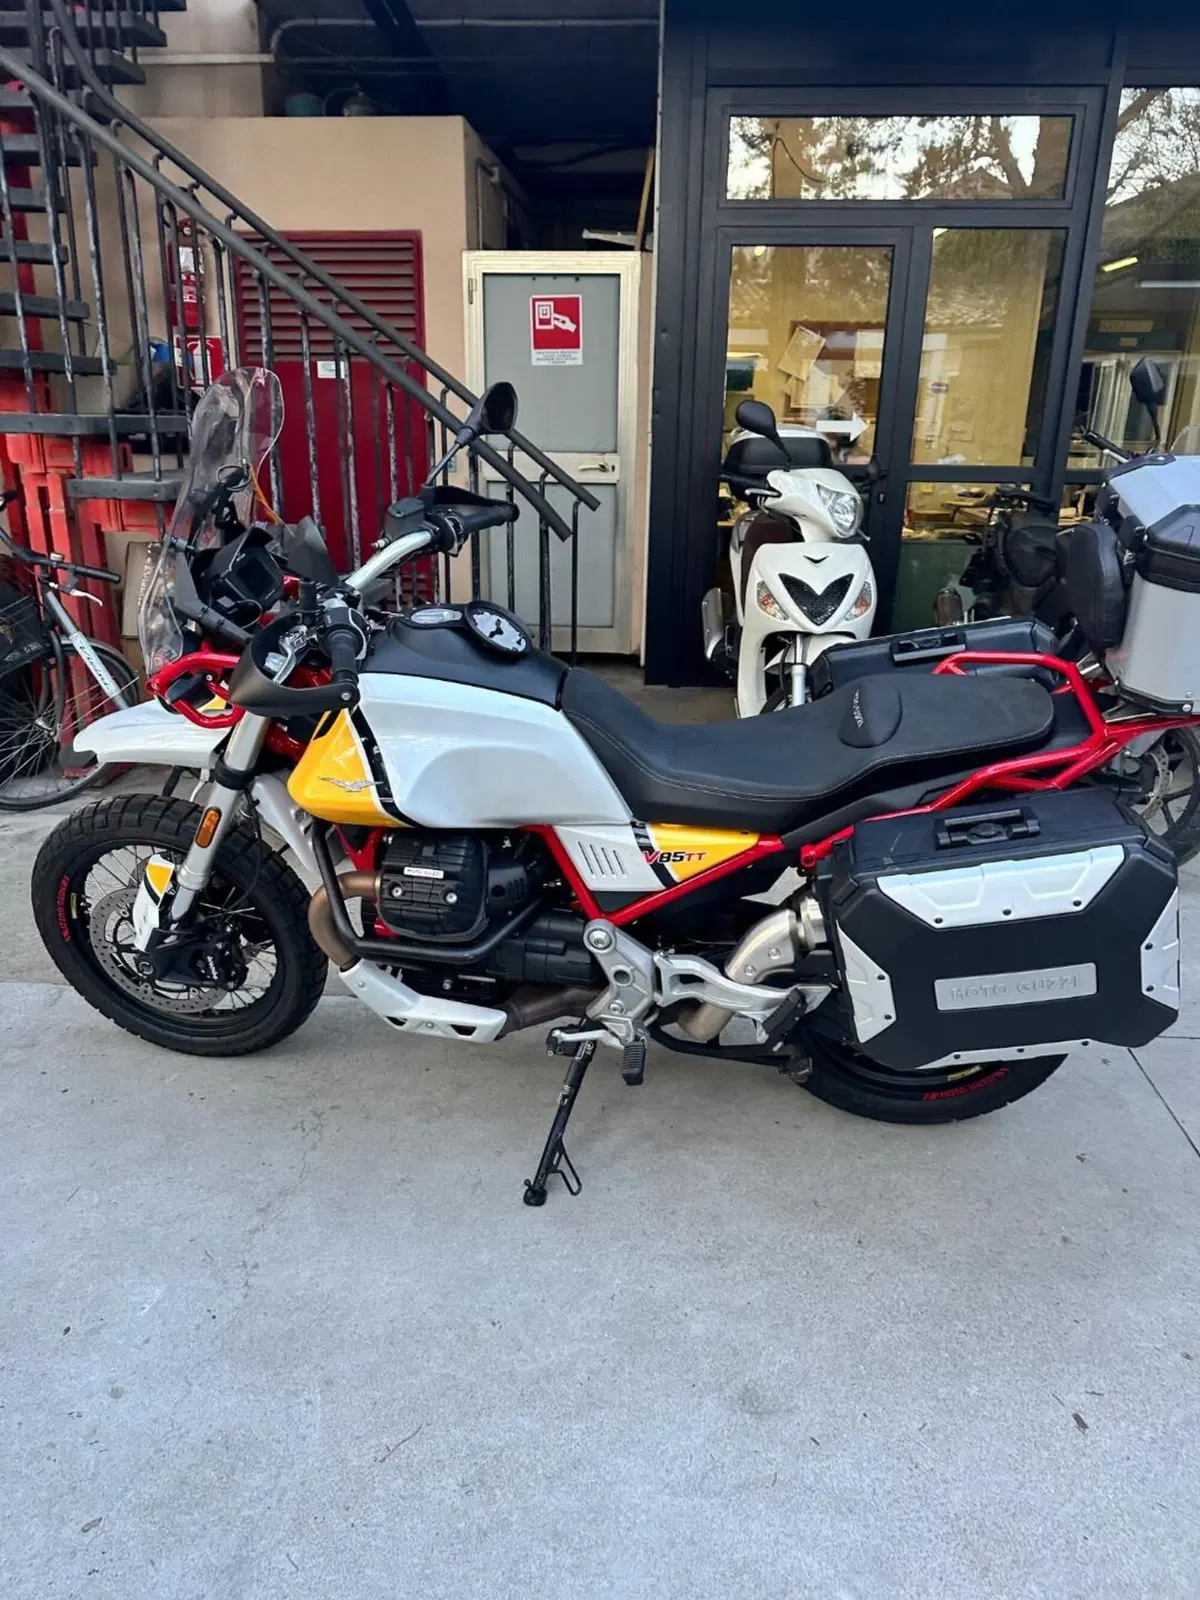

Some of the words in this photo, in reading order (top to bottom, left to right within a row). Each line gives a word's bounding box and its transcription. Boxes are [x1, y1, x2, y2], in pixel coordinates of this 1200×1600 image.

[643, 851, 707, 864] V85TT
[951, 984, 1009, 1001] MOTO
[1015, 975, 1078, 994] GUZZI
